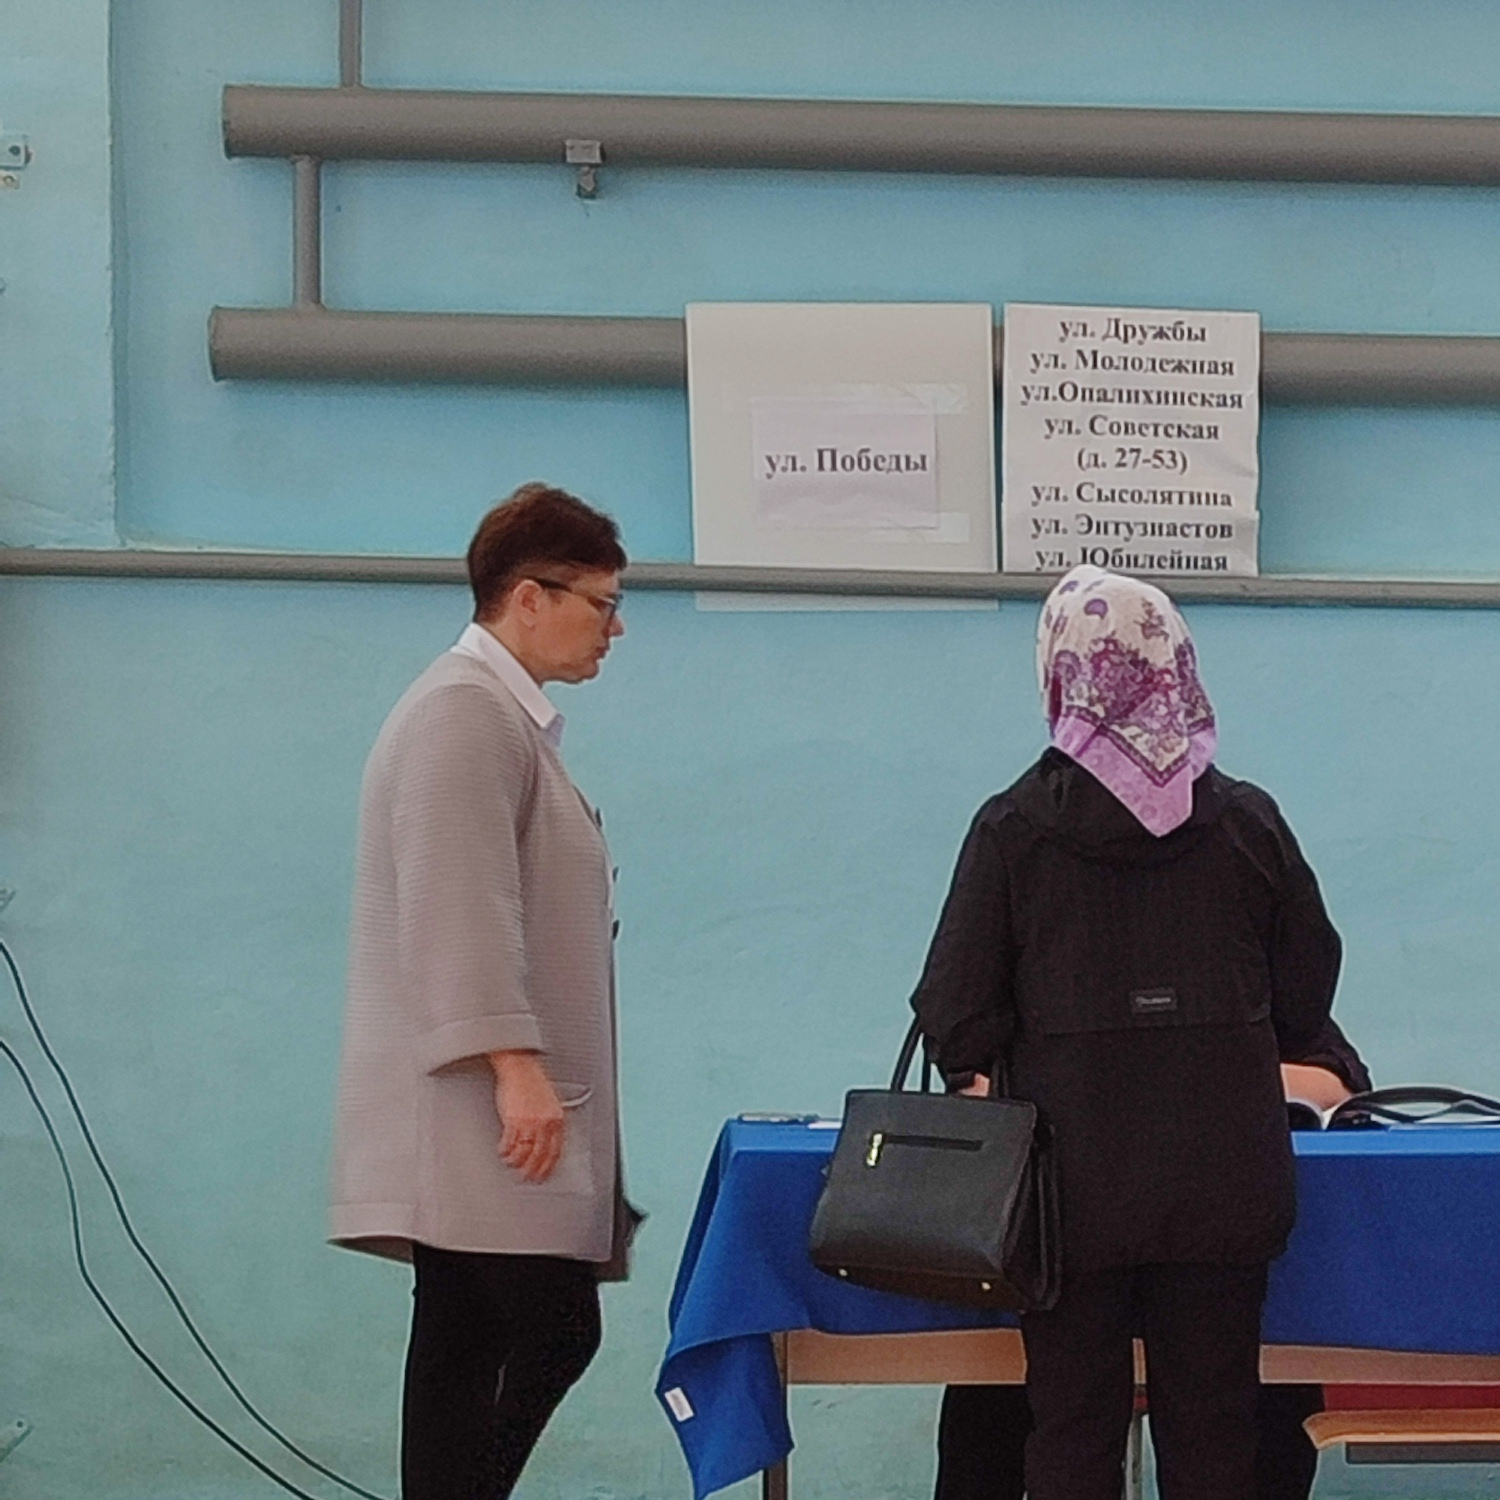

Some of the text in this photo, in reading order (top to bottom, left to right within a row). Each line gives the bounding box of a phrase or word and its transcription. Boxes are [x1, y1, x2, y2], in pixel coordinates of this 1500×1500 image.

[1058, 318, 1207, 345] ул. Дружбы
[1029, 349, 1235, 376] ул. Молодежная
[1043, 413, 1220, 440] ул. Советская
[765, 447, 928, 480] ул. Победы
[1077, 447, 1188, 475] (д. 27-53)
[1030, 481, 1233, 508] ул. Сысолятина
[1030, 513, 1233, 542] ул. Энтузиастов
[1034, 546, 1228, 571] ул. Юбилейная
